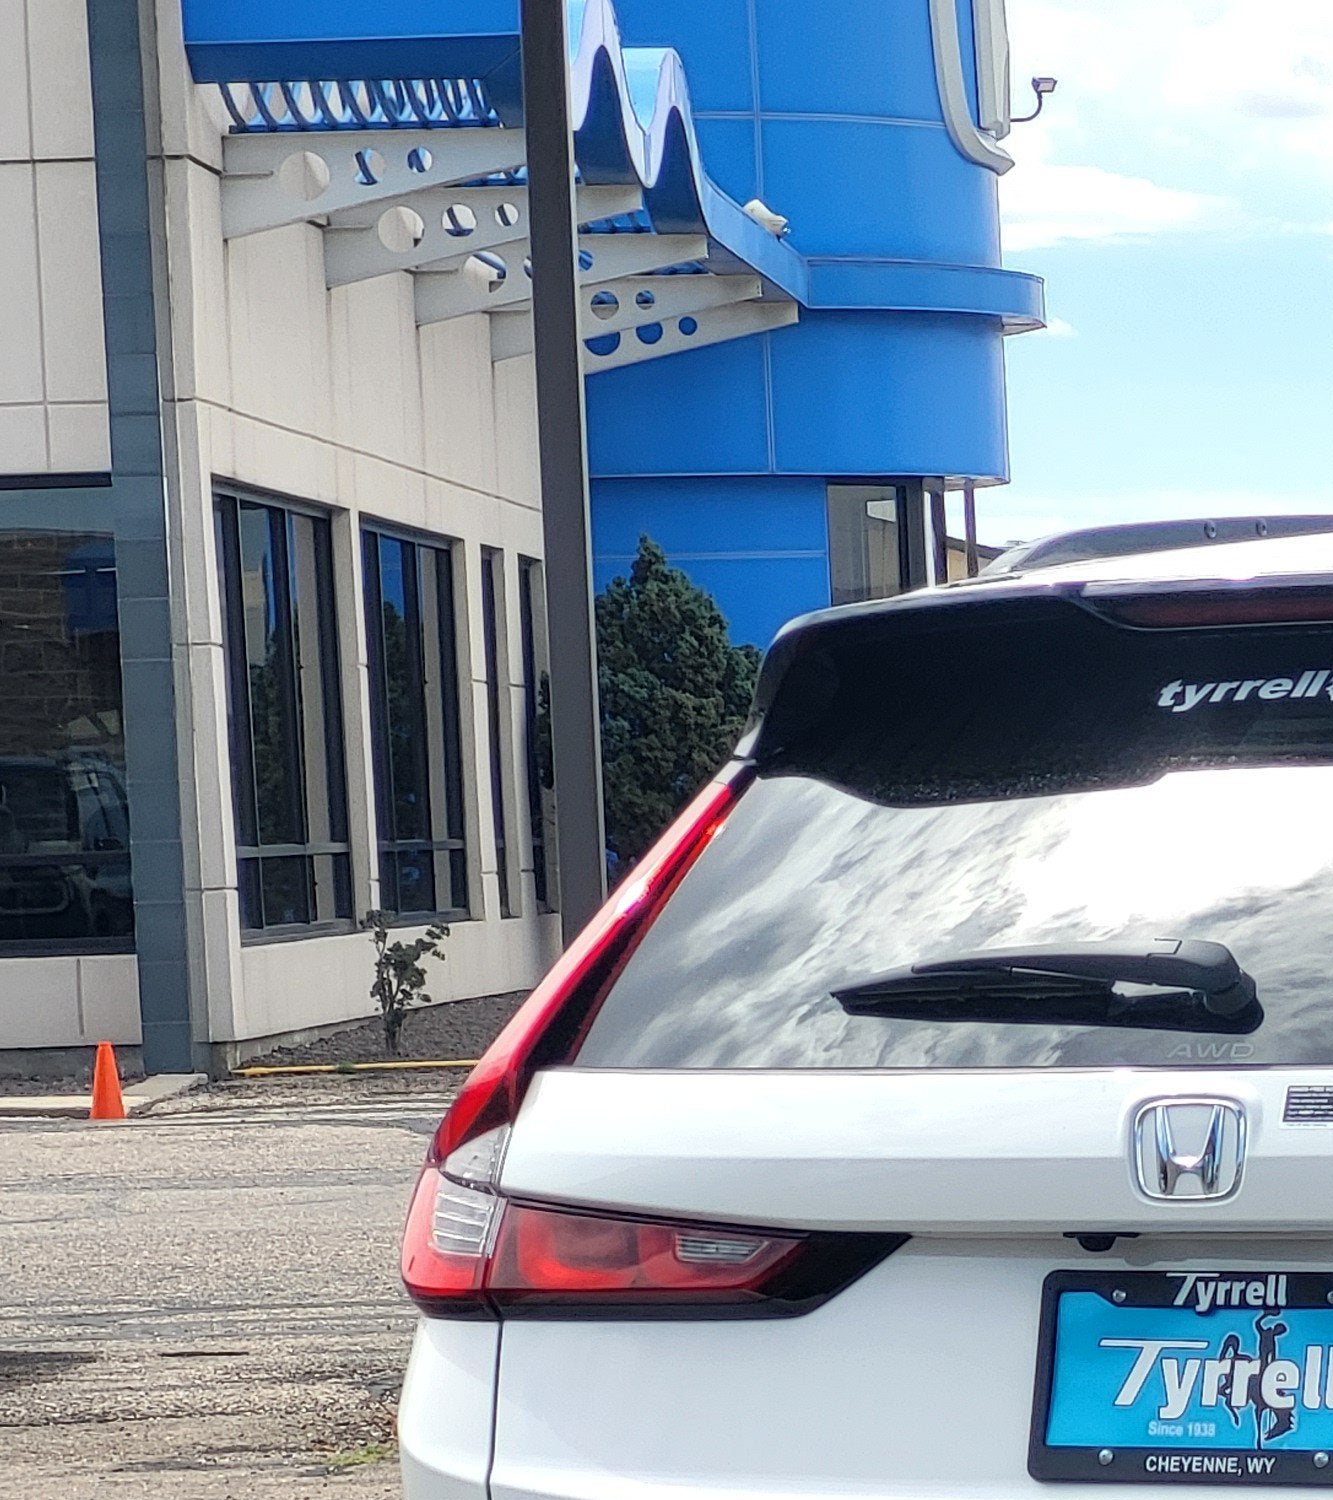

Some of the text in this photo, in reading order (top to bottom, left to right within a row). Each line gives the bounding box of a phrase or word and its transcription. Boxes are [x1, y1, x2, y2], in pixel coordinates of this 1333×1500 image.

[1166, 1042, 1256, 1059] AWD
[1165, 1271, 1288, 1313] Tyrrell
[1147, 1420, 1216, 1438] Since 1938
[1144, 1455, 1277, 1477] CHEYENNE, WY
